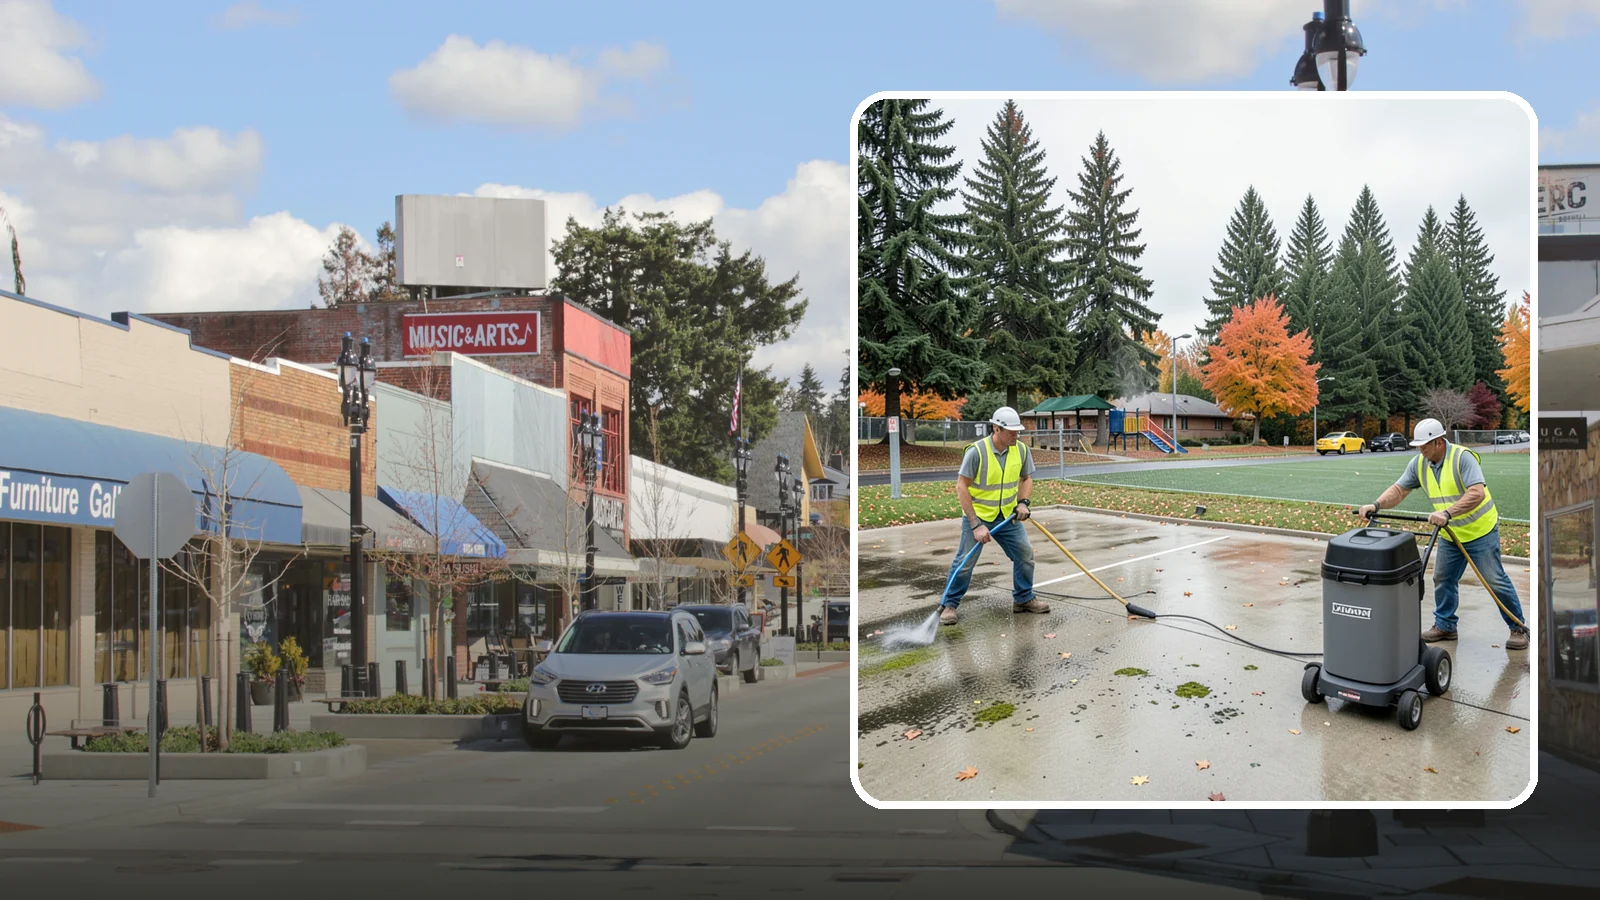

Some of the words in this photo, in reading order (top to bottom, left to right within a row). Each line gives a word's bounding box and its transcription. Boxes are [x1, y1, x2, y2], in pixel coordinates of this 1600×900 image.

[409, 323, 519, 349] MUSIC&ARTS
[0, 471, 79, 515] Furniture
[453, 563, 480, 574] SUSHI
